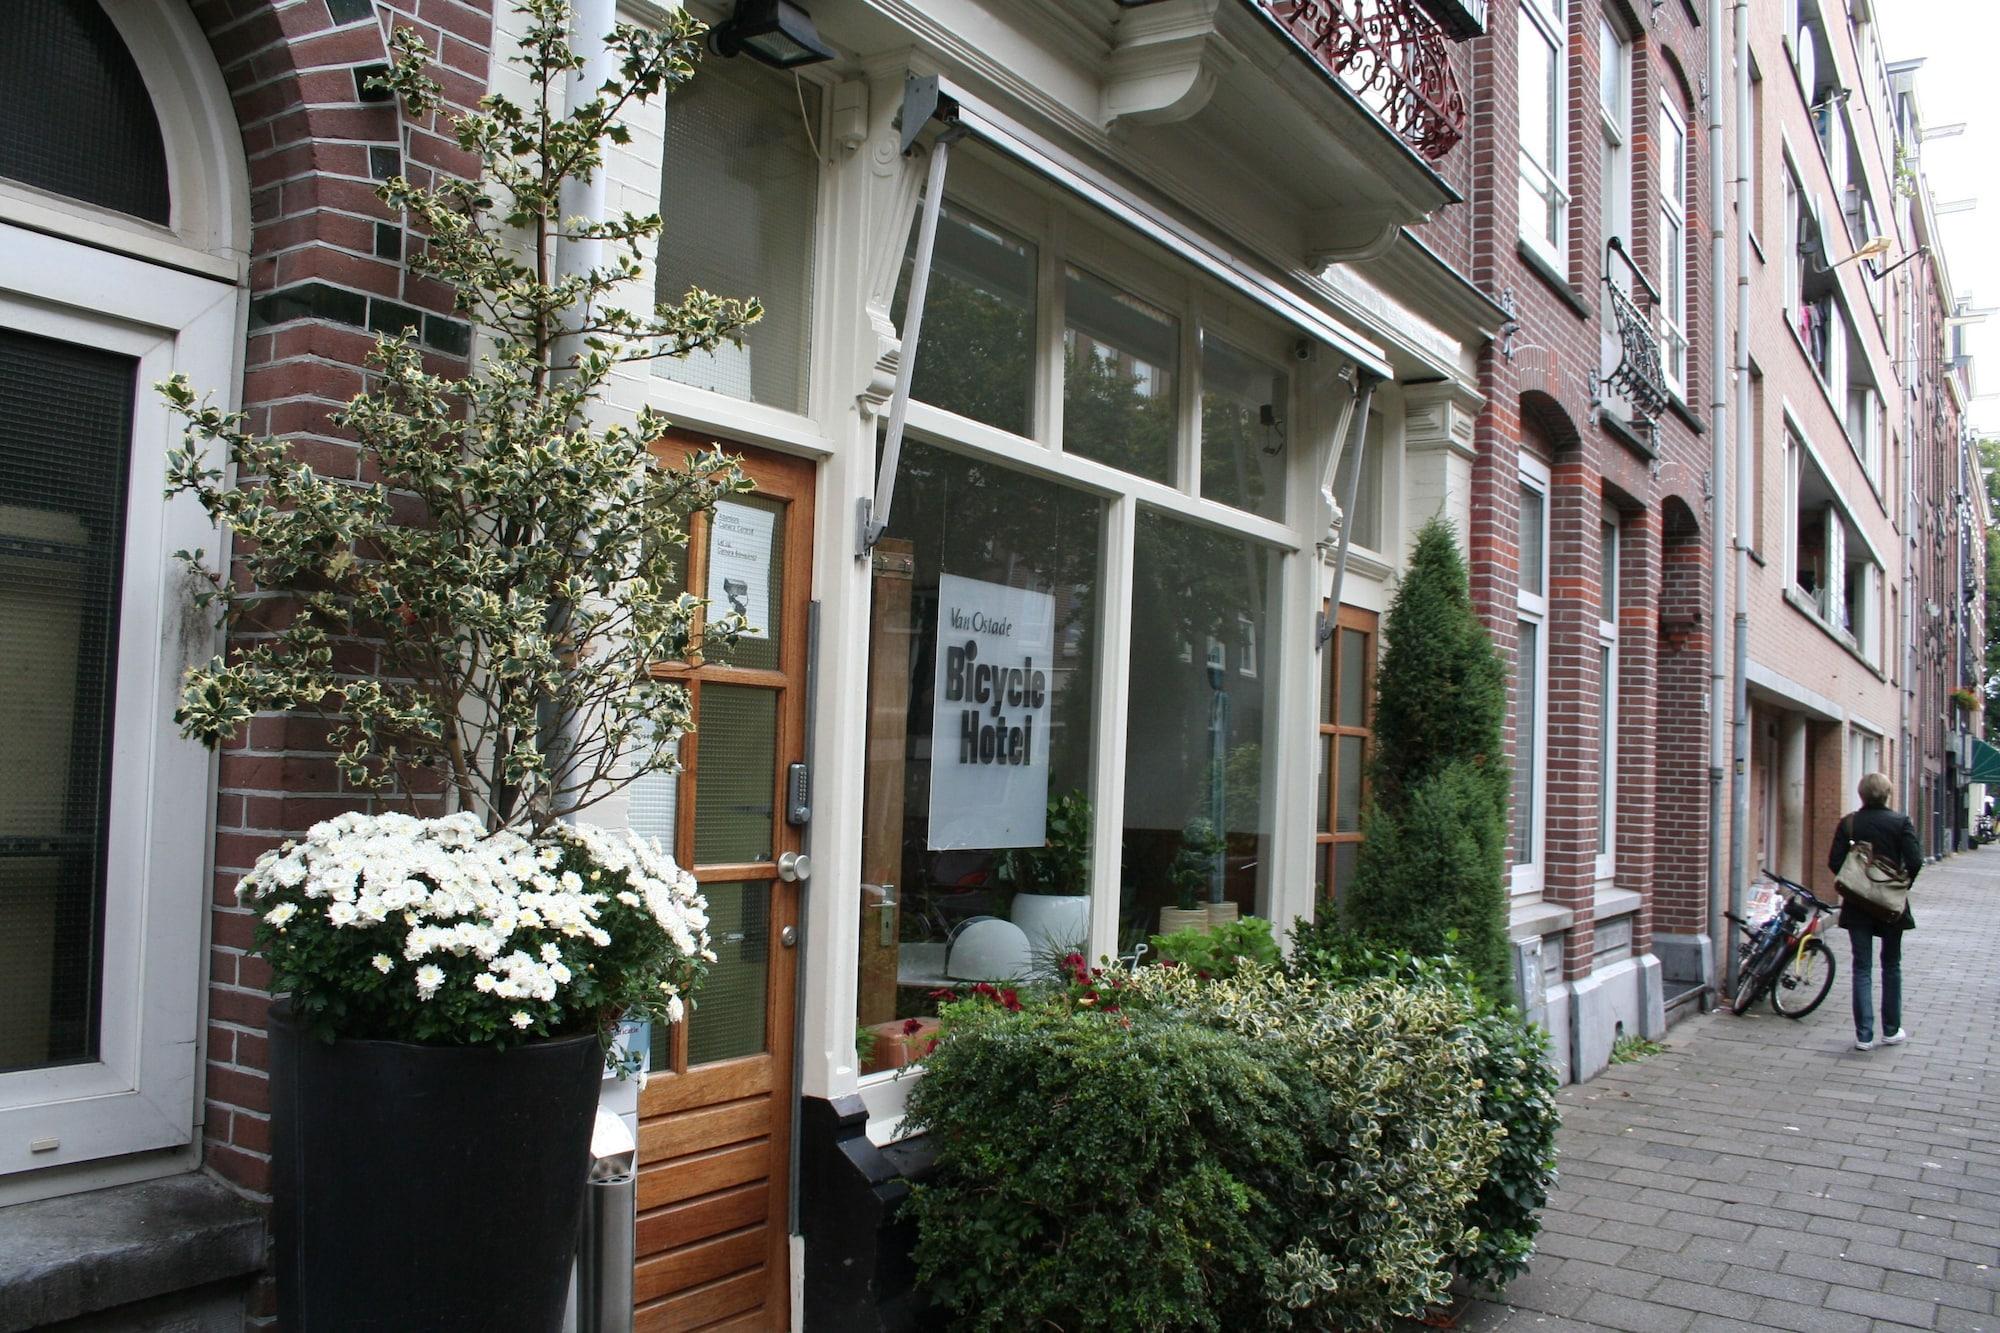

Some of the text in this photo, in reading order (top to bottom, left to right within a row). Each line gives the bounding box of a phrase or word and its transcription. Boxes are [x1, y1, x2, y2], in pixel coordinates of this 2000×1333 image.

[951, 607, 1012, 637] Van Ostade
[946, 640, 1046, 717] Bicycle
[960, 710, 1032, 765] Hotel
